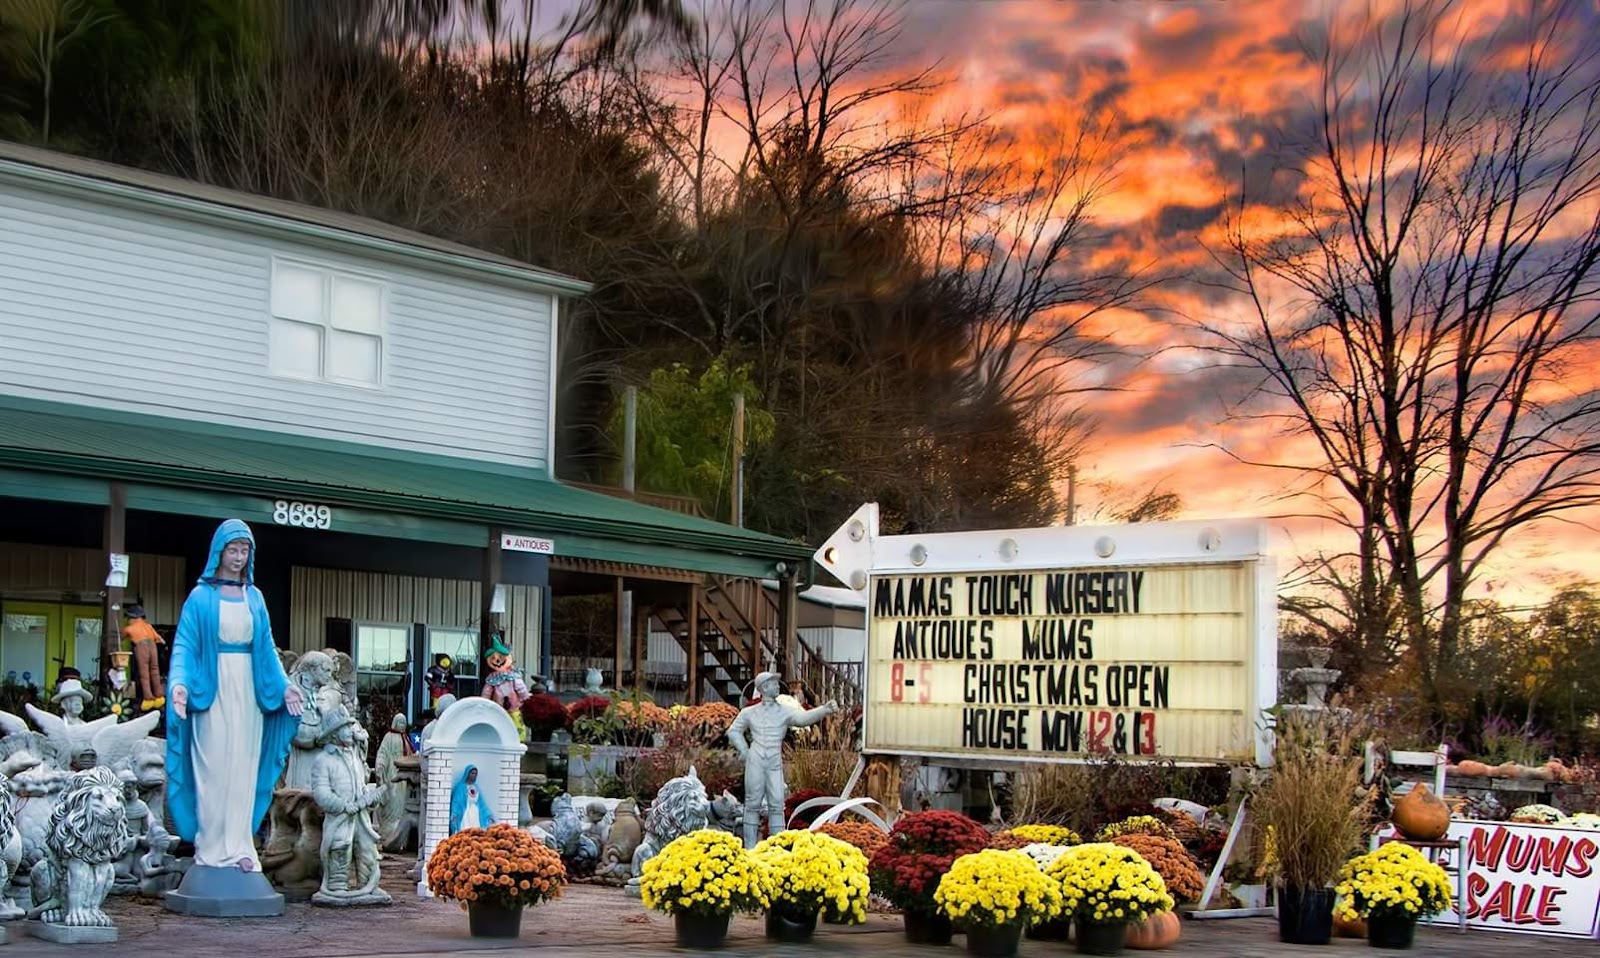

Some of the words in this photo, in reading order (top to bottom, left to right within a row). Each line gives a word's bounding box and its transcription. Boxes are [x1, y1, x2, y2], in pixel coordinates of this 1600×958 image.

[273, 500, 331, 530] 8689
[514, 538, 551, 551] ANTIQUES
[874, 577, 954, 617] MAMAS
[965, 574, 1034, 616] TOUCH
[1046, 571, 1145, 615] NURSERY
[893, 619, 994, 660] ANTIQUES
[1022, 619, 1094, 661] MUMS
[963, 663, 1099, 706] CHRISTMAS
[1106, 664, 1170, 709] OPEN
[963, 707, 1030, 750] HOUSE
[1466, 824, 1598, 878] MUMS
[1452, 872, 1567, 925] SALE
